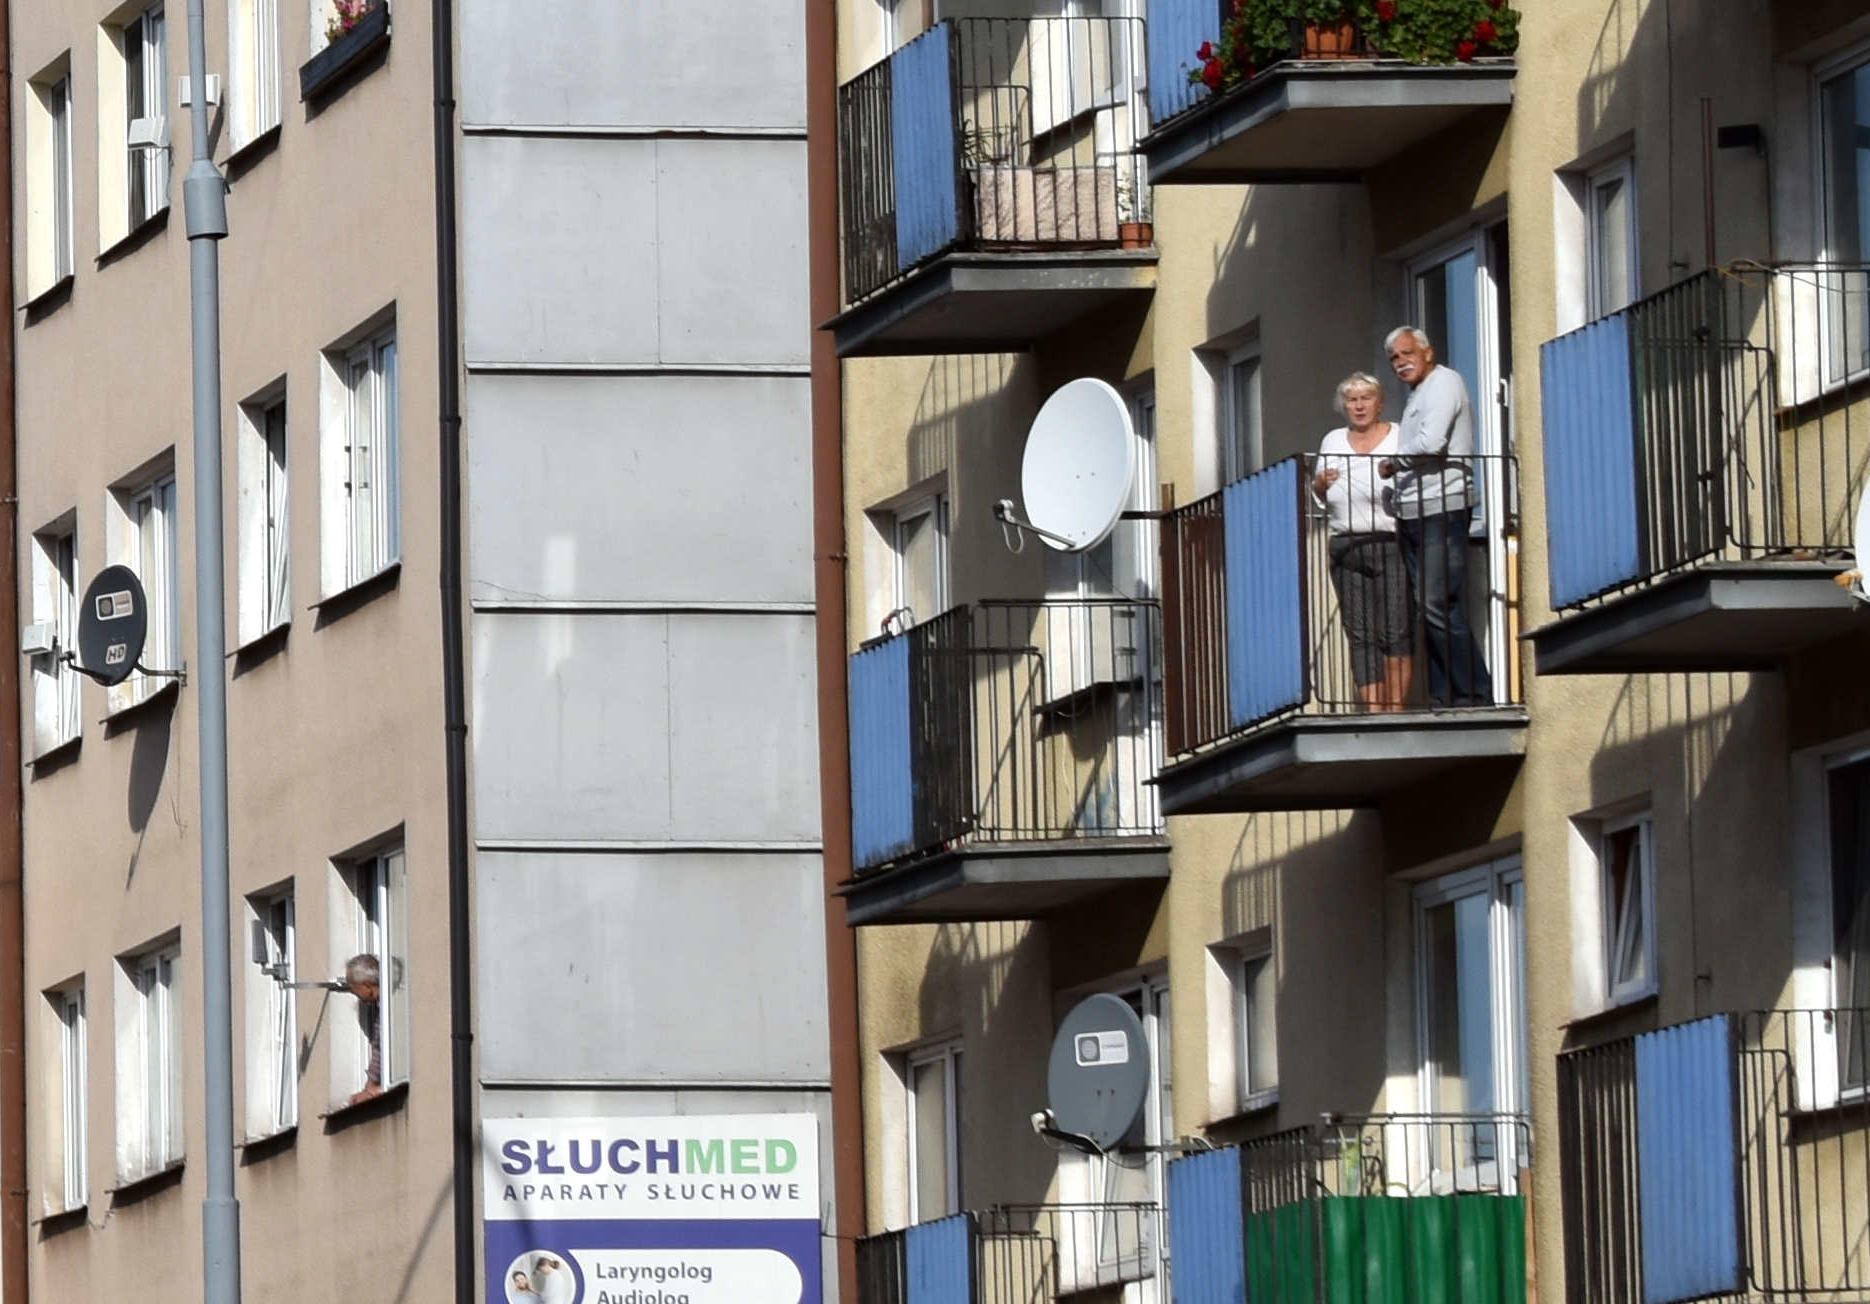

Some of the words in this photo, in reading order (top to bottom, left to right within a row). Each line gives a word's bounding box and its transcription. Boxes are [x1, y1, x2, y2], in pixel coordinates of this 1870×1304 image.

[107, 645, 126, 659] HD
[501, 1138, 798, 1175] SŁUCHMED
[503, 1183, 628, 1201] APARATY
[647, 1182, 801, 1201] SŁUCHOWE
[596, 1261, 713, 1284] Laryngolog
